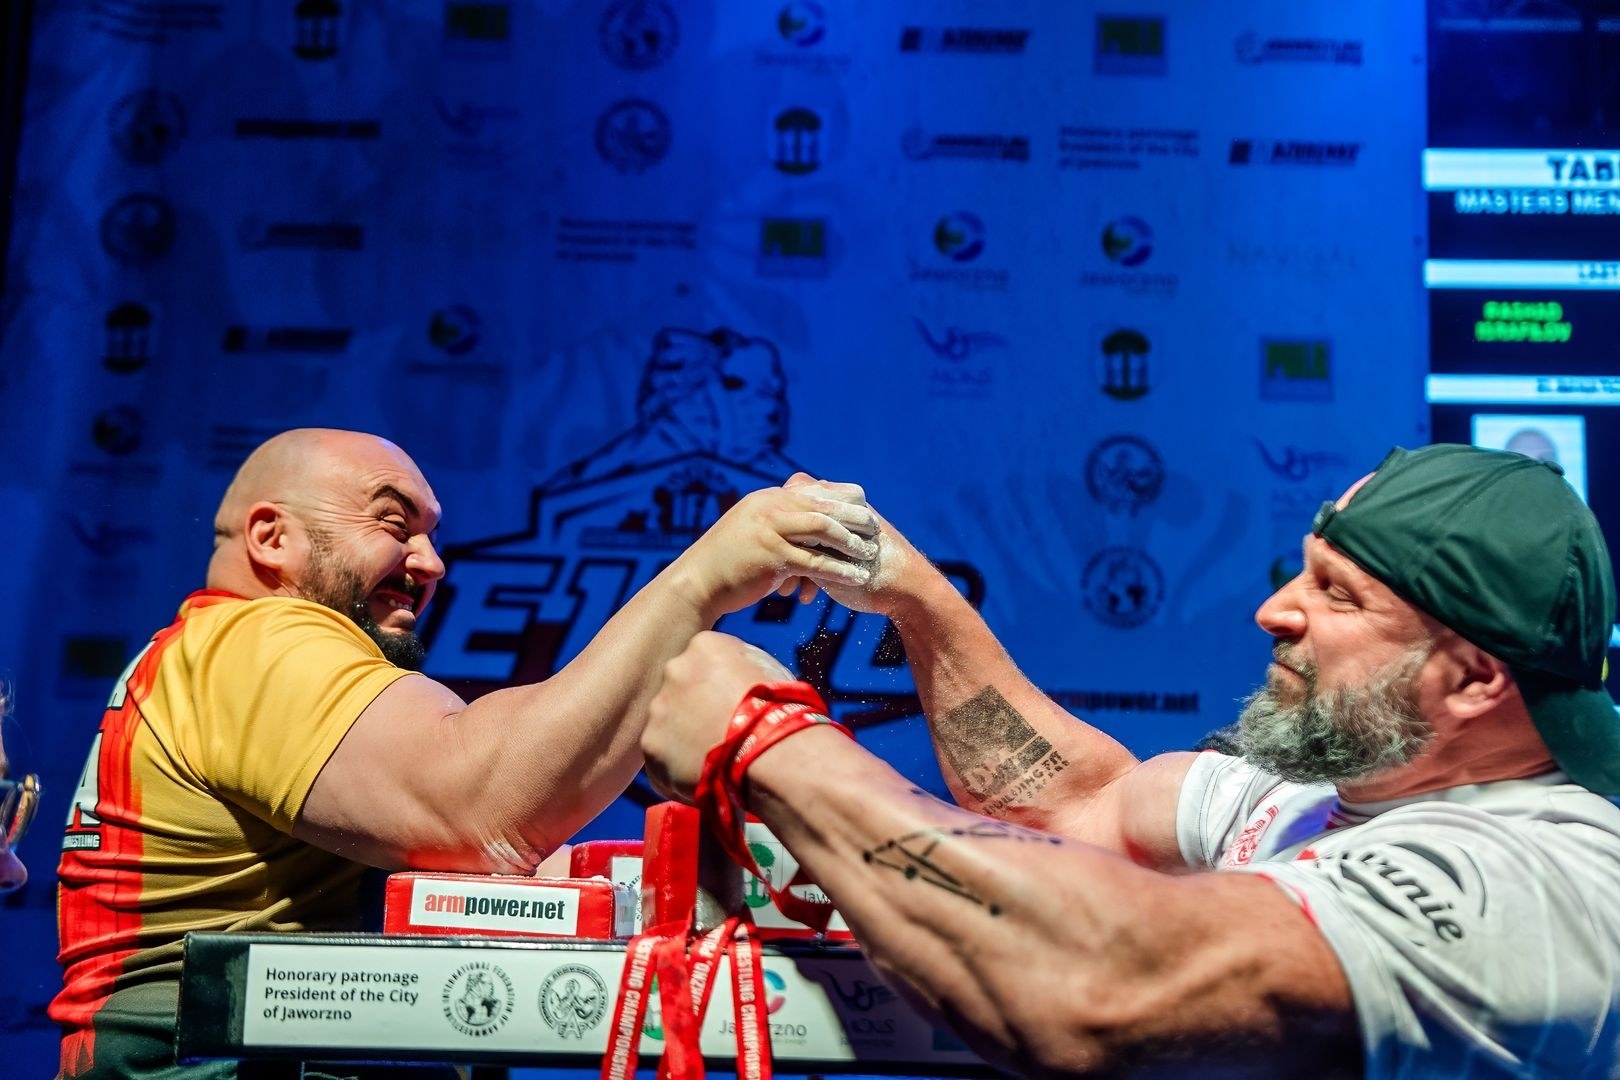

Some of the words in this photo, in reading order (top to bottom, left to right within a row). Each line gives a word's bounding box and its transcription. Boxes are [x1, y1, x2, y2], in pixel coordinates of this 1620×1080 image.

[1547, 157, 1620, 182] TAB
[424, 893, 566, 920] armpower.net
[266, 967, 337, 985] Honorary
[341, 970, 420, 987] patronage
[735, 941, 756, 1003] RESTLING
[264, 986, 337, 1001] President
[340, 987, 357, 1001] of
[360, 989, 385, 1002] the
[389, 988, 420, 1006] City
[263, 1005, 280, 1019] of
[280, 1006, 352, 1022] Jaworzno
[718, 1019, 808, 1037] Jarzno
[740, 1003, 762, 1080] CHAMPIONS
